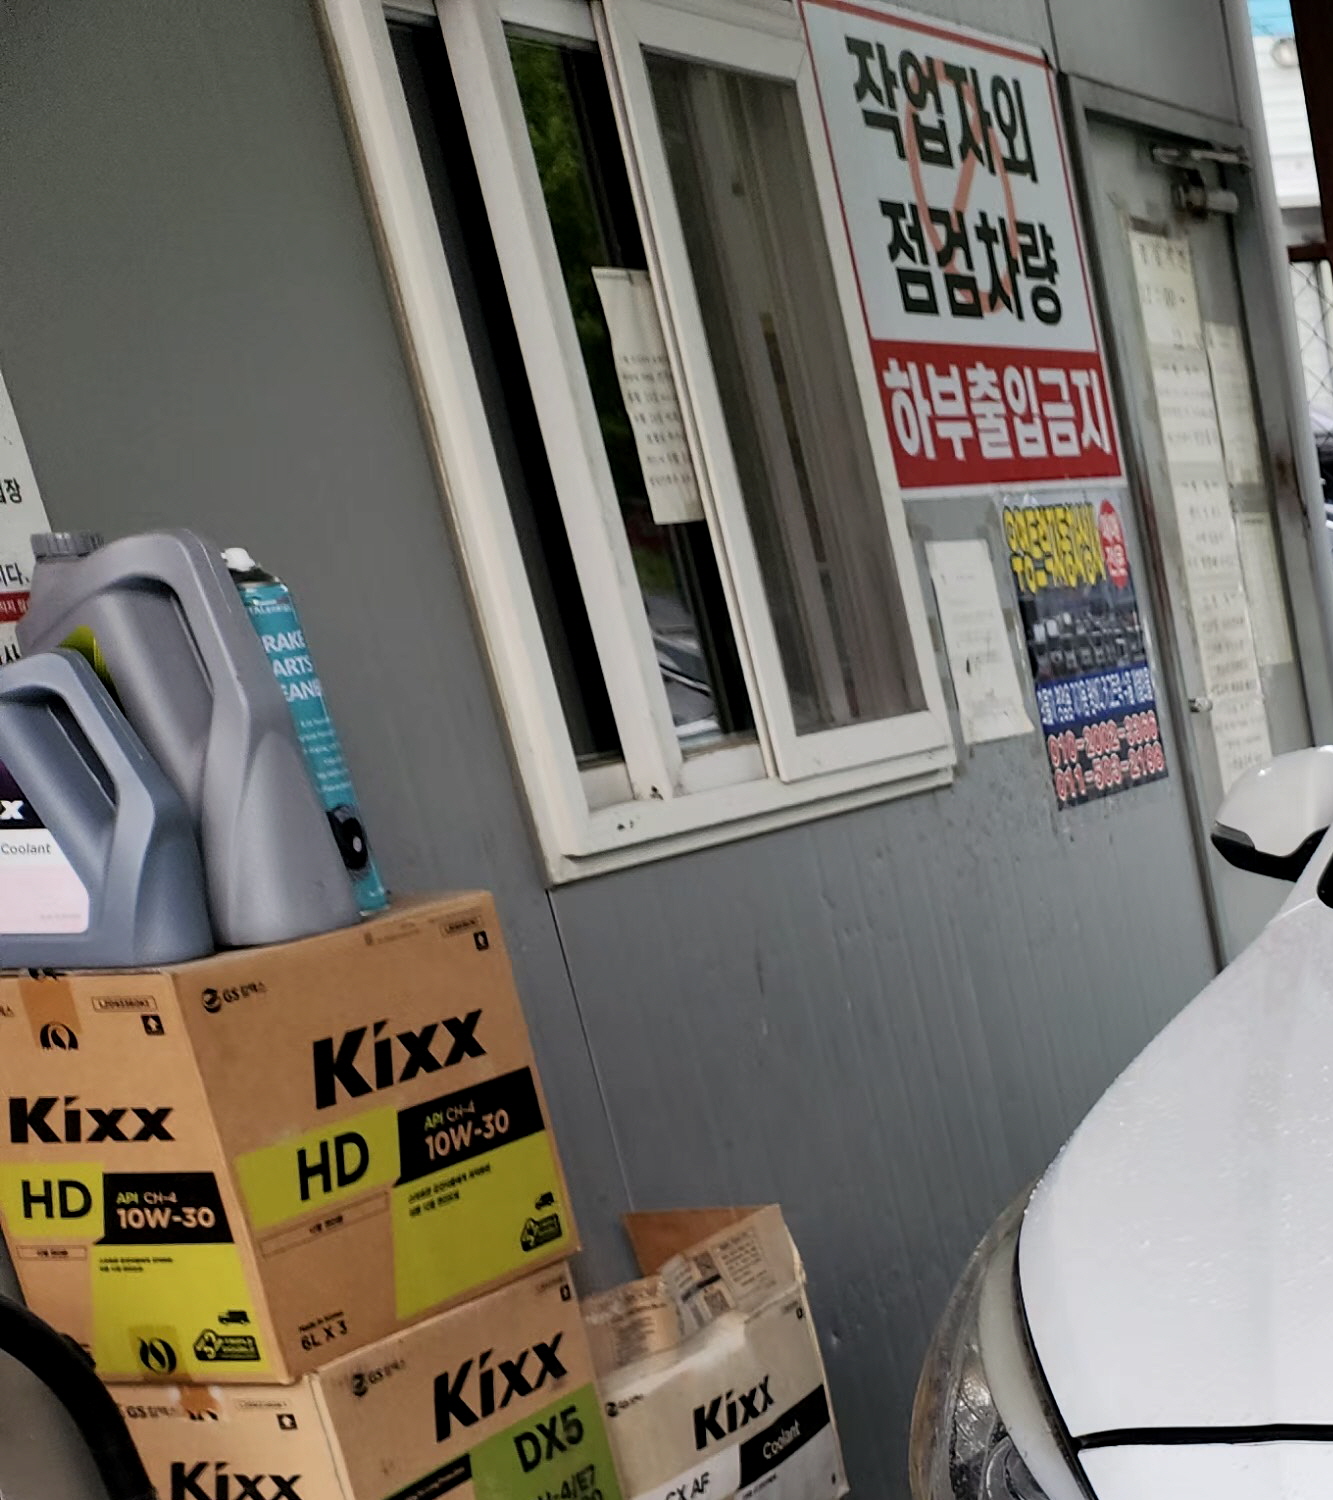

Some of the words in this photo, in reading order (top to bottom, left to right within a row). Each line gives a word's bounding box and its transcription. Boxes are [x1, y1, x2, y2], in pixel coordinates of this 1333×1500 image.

[845, 36, 1038, 183] 작업자외
[879, 199, 1062, 326] 점검차량
[883, 357, 1112, 462] 하부출입금지
[261, 628, 306, 653] RAKE
[272, 654, 314, 677] ARTS
[1, 842, 52, 855] Coolant
[313, 1008, 488, 1110] Kixx
[9, 1095, 175, 1143] Kixx
[425, 1109, 509, 1160] 10W-30
[298, 1132, 369, 1201] HD
[21, 1179, 92, 1219] HD
[116, 1192, 138, 1204] API
[117, 1207, 216, 1229] 10W-30
[434, 1331, 567, 1443] Kixx
[693, 1374, 775, 1451] Kixx
[514, 1405, 584, 1473] DX5
[763, 1420, 801, 1459] Coolant
[690, 1472, 711, 1499] AF
